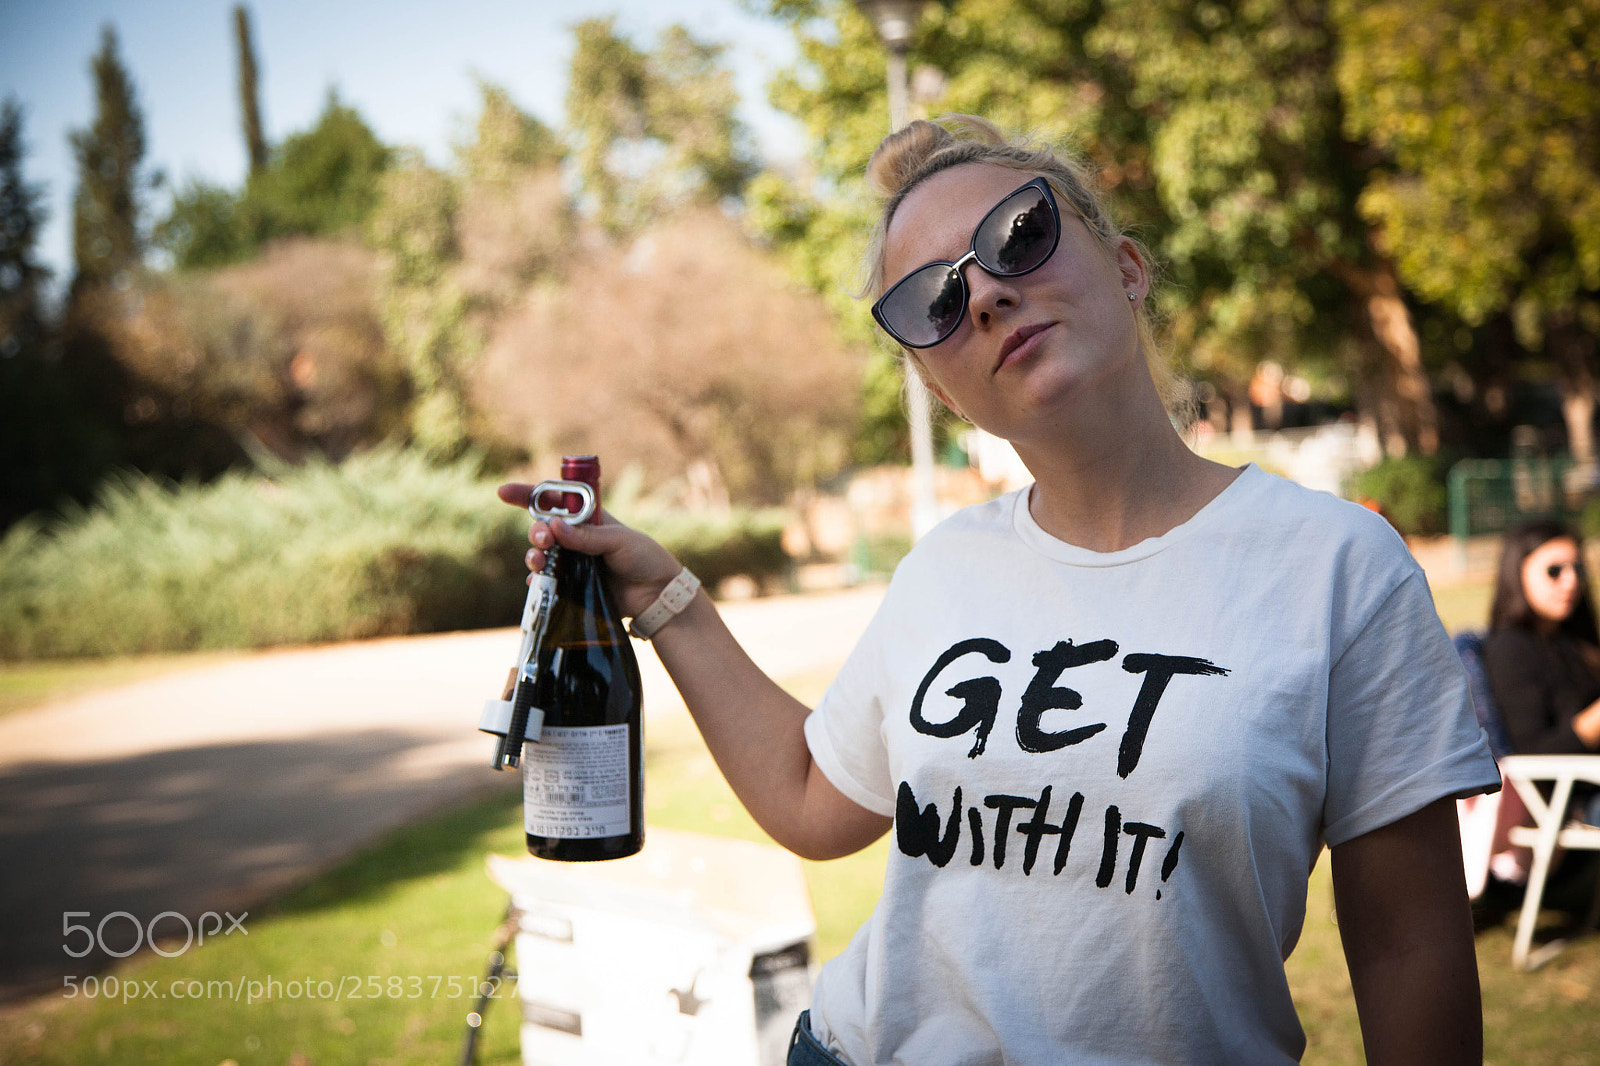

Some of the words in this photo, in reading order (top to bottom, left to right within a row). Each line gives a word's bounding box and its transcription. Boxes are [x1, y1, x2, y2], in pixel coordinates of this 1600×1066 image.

[909, 637, 1232, 780] GET
[896, 781, 1085, 876] WITH
[1095, 805, 1184, 900] IT!
